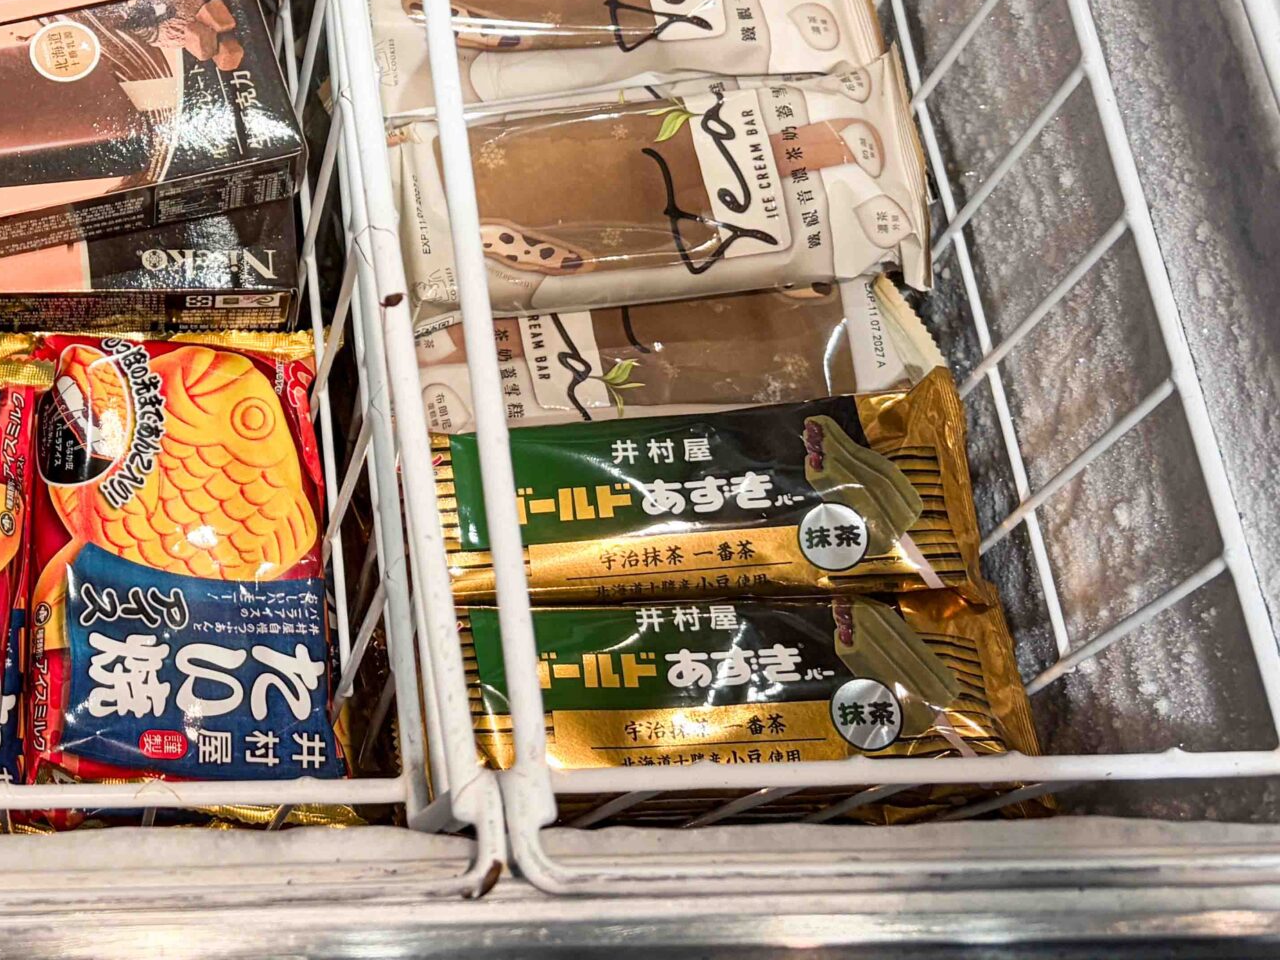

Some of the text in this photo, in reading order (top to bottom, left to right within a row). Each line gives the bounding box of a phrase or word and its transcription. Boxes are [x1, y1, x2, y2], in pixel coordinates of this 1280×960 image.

[47, 31, 69, 72] 北海道
[741, 108, 779, 219] ICE CREAM BAR
[526, 314, 551, 381] REAM BAR
[2, 392, 26, 479] アイスミルク
[611, 437, 714, 465] 井村屋
[600, 540, 757, 572] 宇治抹茶 一番茶
[804, 524, 862, 550] 抹茶
[79, 582, 189, 631] アイス
[635, 605, 740, 633] 井村屋
[87, 632, 326, 722] たい焼
[32, 658, 50, 752] アイスミルク
[723, 714, 789, 737] 一番茶
[837, 701, 896, 728] 抹茶
[197, 728, 327, 770] 井村屋
